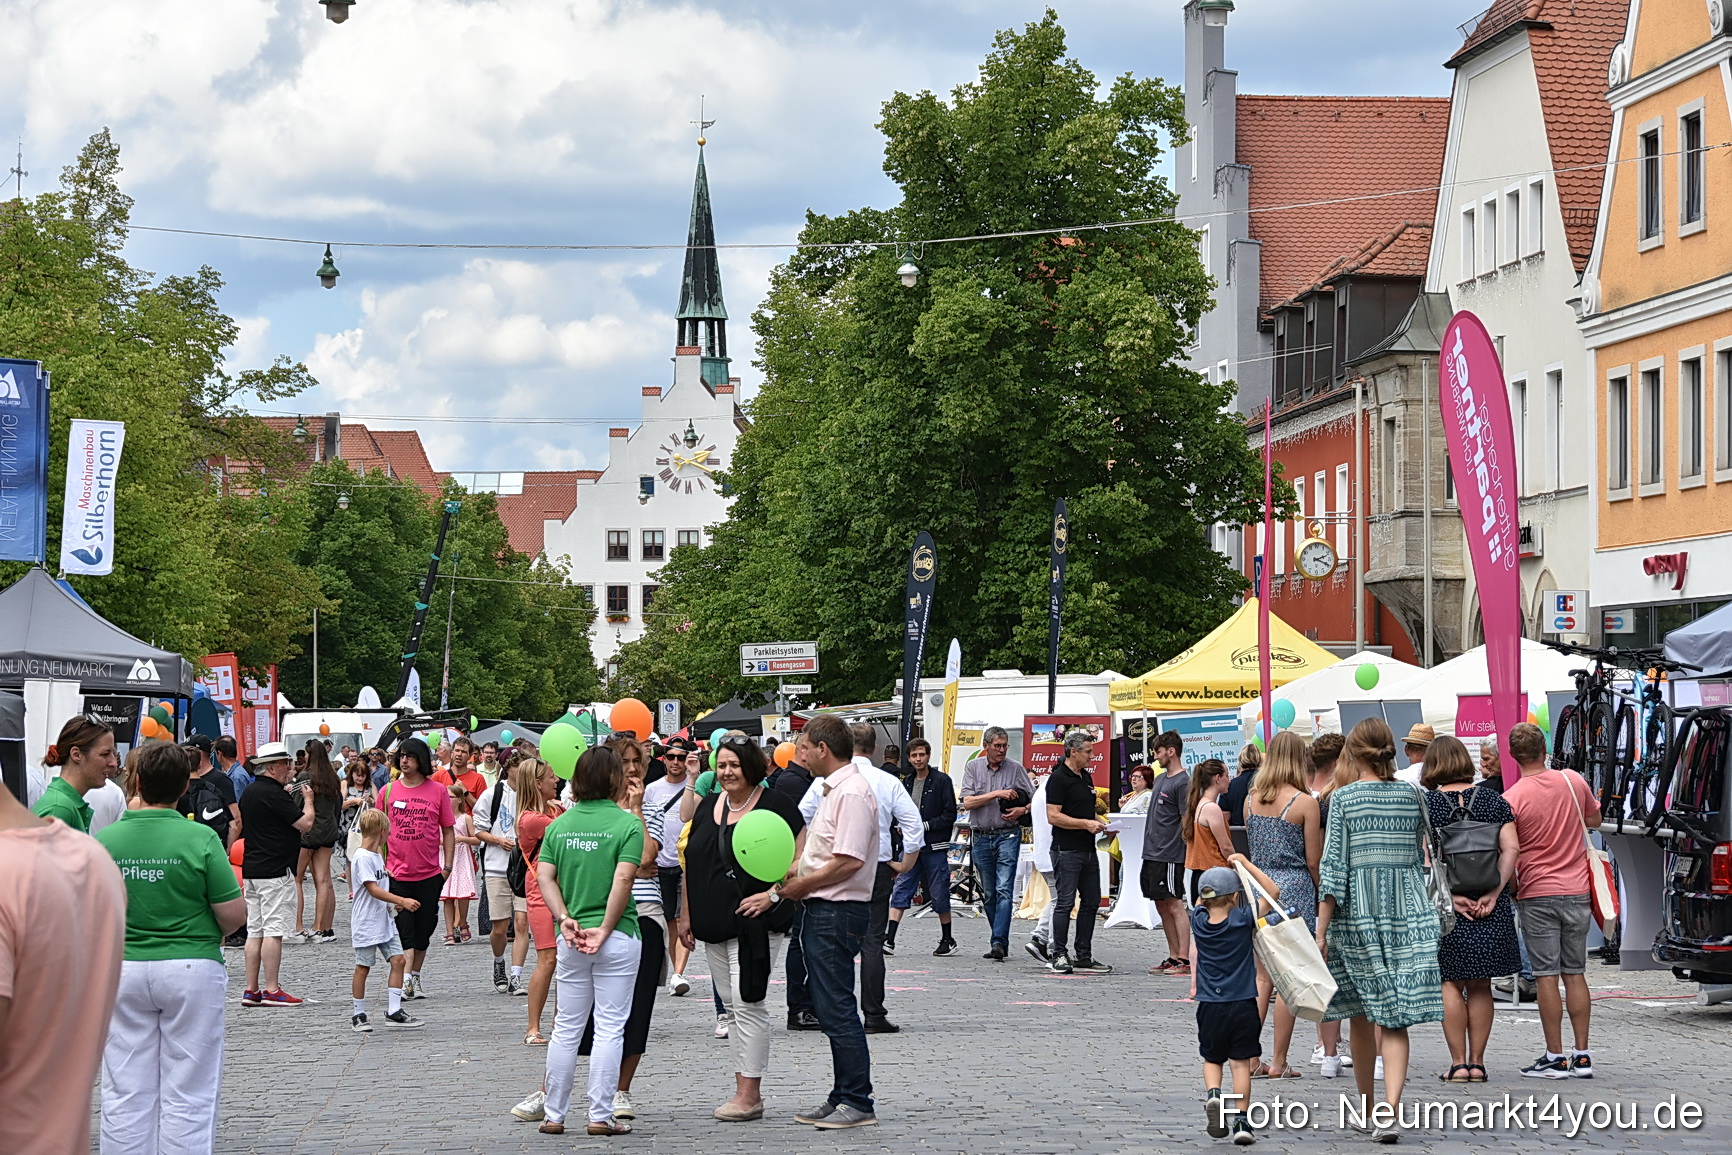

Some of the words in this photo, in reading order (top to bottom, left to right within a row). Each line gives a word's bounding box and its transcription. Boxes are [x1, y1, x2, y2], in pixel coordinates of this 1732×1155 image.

[78, 429, 94, 509] Maschinenbau
[82, 430, 116, 541] Silberhorn
[1519, 520, 1532, 544] ank
[753, 647, 804, 656] Parkleitsystem
[42, 660, 115, 678] NEUMARKT
[1156, 686, 1262, 699] www.baecke
[1459, 720, 1475, 731] Wir
[1477, 720, 1497, 732] stelle
[1031, 753, 1049, 761] Hier
[1185, 751, 1206, 764] aha
[1210, 750, 1224, 761] ist
[566, 837, 599, 852] Pflege
[121, 866, 165, 882] Pflege
